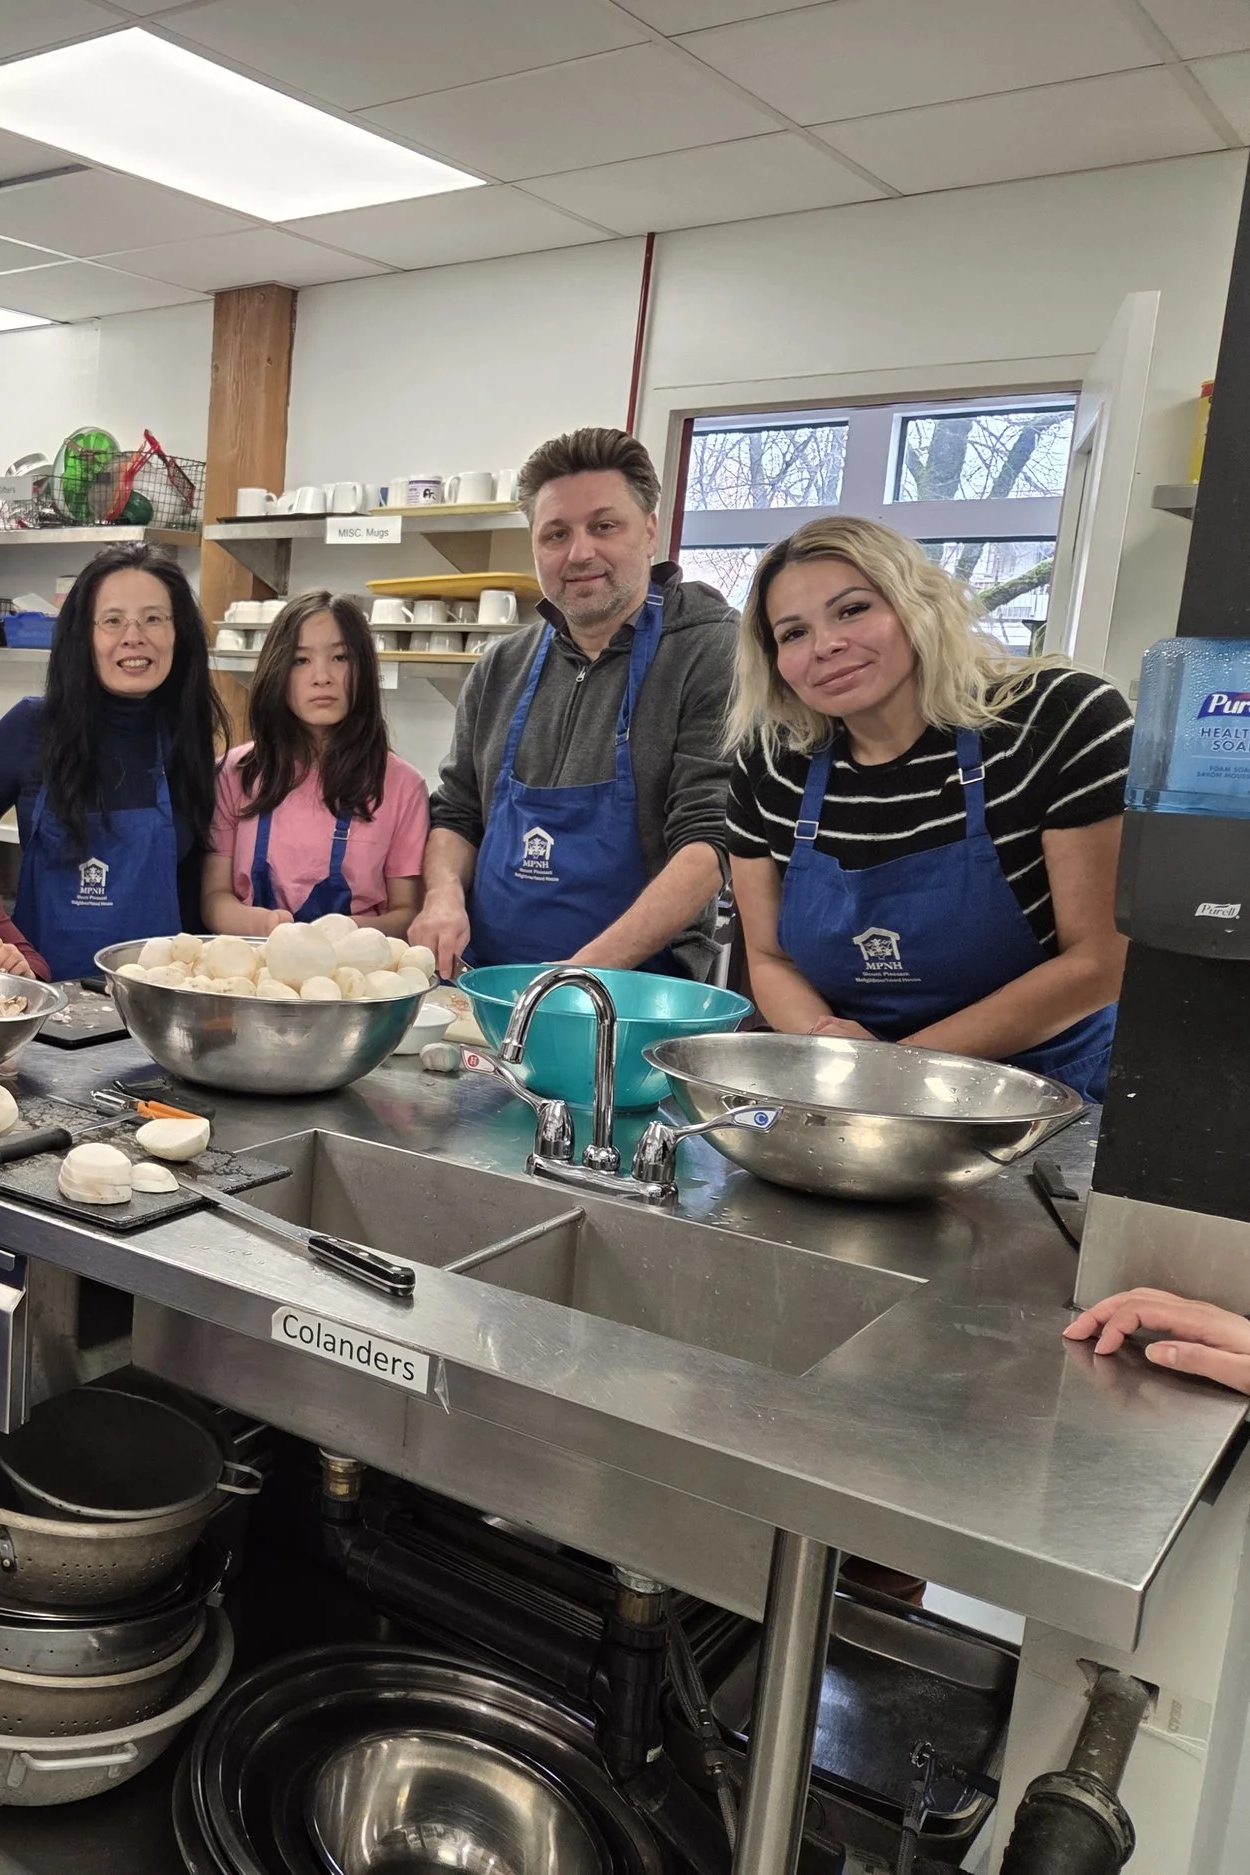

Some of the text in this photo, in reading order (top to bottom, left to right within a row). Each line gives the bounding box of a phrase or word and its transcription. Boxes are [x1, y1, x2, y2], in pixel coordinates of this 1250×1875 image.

[366, 528, 389, 539] Mugs
[1208, 693, 1250, 714] Pur
[1212, 740, 1250, 751] SOA
[523, 860, 549, 868] MPNH
[79, 887, 105, 895] MPNH
[1202, 904, 1236, 916] Purell
[865, 961, 903, 970] MPNH
[282, 1313, 415, 1381] Colanders
